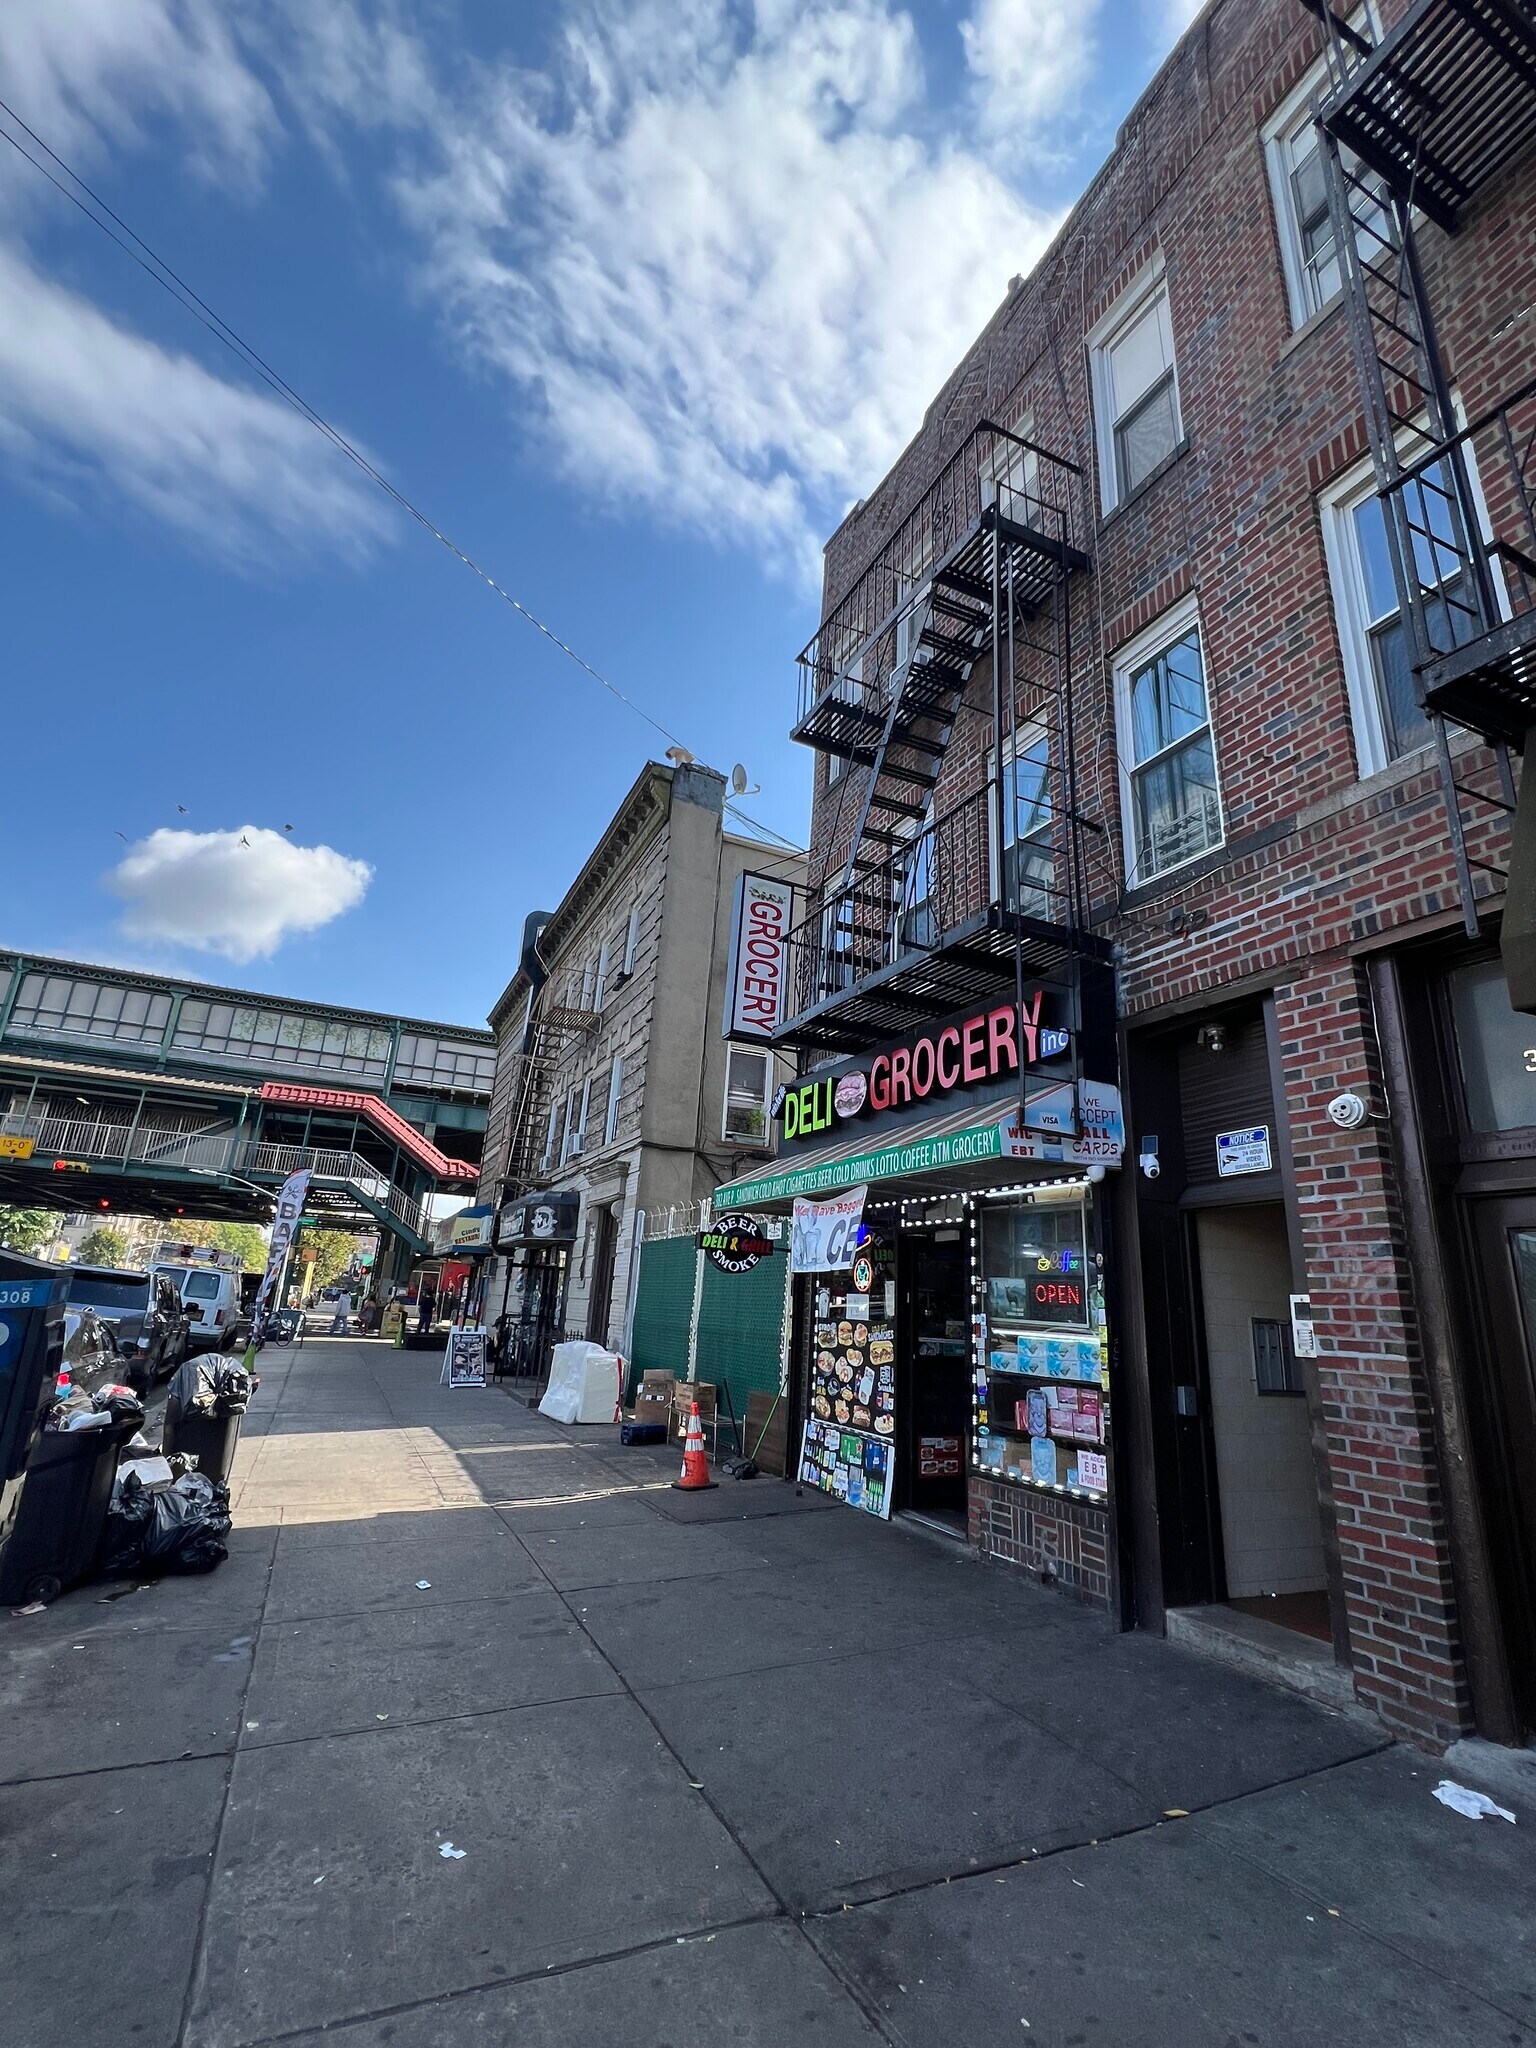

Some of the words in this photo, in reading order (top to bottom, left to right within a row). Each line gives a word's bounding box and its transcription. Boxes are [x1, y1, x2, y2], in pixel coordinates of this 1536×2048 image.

[742, 901, 782, 1033] GROCERY
[870, 990, 1043, 1110] GROCERY
[785, 1077, 832, 1139] DELI
[1084, 1098, 1100, 1107] WE
[1042, 1116, 1059, 1124] VISA
[1082, 1127, 1111, 1139] ALL
[1230, 1132, 1255, 1145] NOTICE
[1011, 1145, 1035, 1156] EBT
[1072, 1141, 1119, 1155] CARDS
[817, 1168, 833, 1188] BEER
[832, 1164, 850, 1184] COLD
[850, 1158, 874, 1181] DRINKS
[876, 1154, 899, 1176] LOTTO
[901, 1145, 930, 1170] COFFEE
[932, 1141, 950, 1164] ATM
[952, 1132, 996, 1159] GROCERY
[717, 1217, 758, 1236] BEER
[702, 1234, 728, 1249] DELI
[713, 1250, 759, 1272] SMOKE
[1050, 1250, 1079, 1272] Coffee
[0, 1291, 30, 1304] 308
[1035, 1284, 1080, 1304] OPEN
